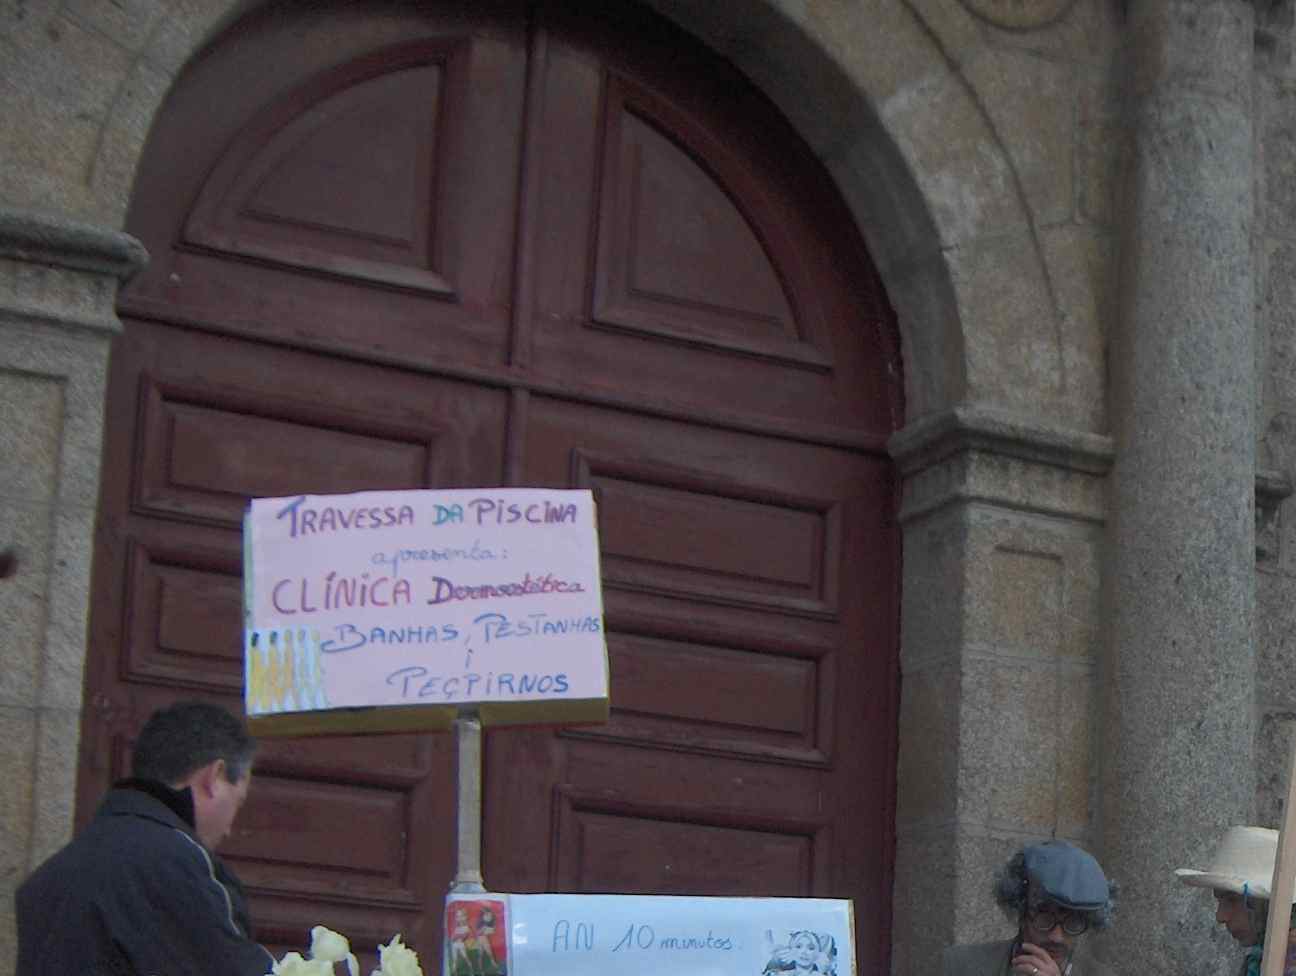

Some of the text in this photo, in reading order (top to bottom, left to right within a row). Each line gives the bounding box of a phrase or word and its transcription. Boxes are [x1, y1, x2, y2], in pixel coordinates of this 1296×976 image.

[276, 496, 414, 537] TRAVESSA
[432, 504, 463, 525] DA
[473, 612, 601, 643] PESTANHAS
[552, 919, 595, 952] AN
[612, 923, 655, 952] 10
